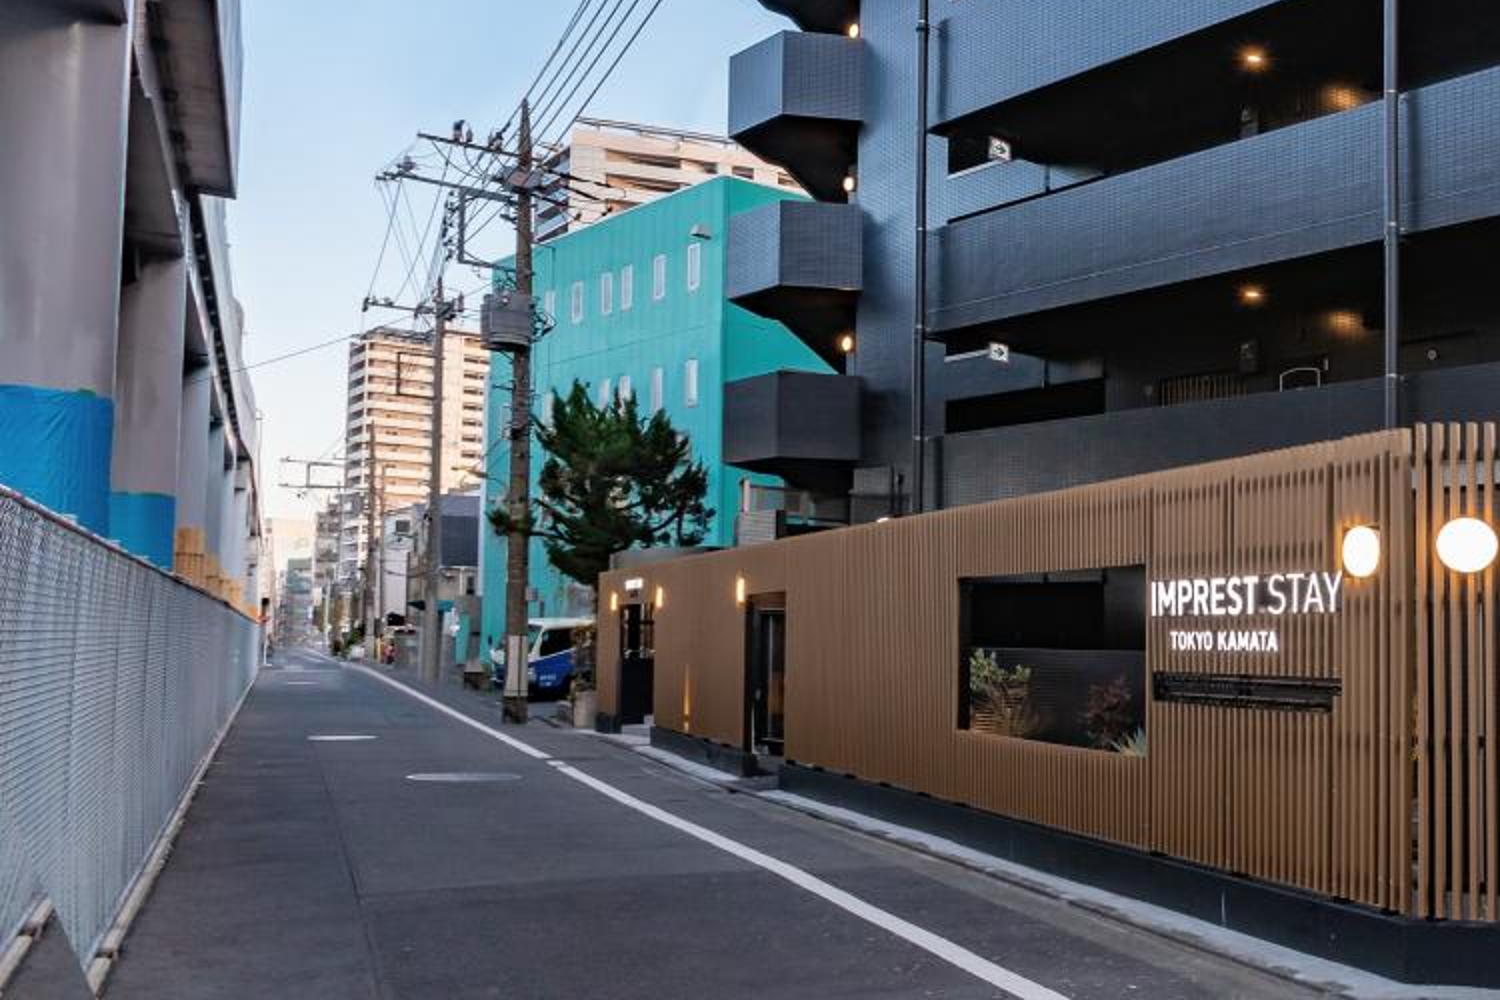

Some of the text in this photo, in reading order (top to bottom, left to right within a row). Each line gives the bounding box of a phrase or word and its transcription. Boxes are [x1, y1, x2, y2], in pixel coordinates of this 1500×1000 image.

[1151, 571, 1342, 617] IMPREST STAY
[1170, 629, 1278, 652] TOKYO KAMATA
